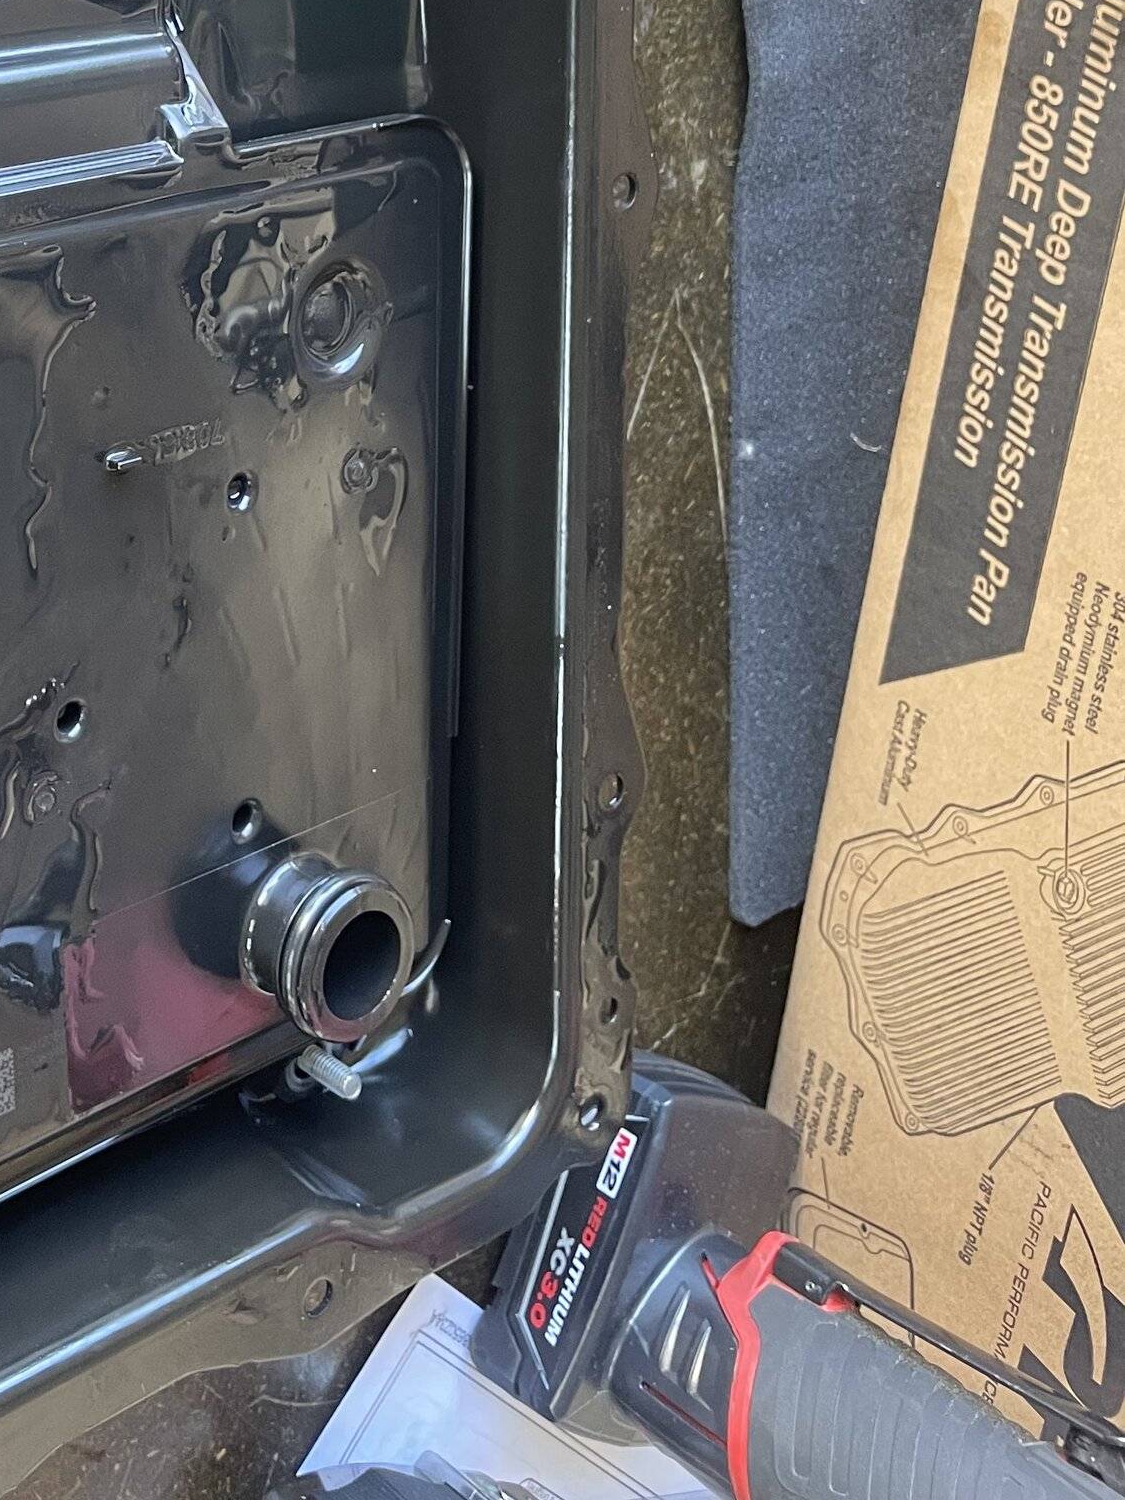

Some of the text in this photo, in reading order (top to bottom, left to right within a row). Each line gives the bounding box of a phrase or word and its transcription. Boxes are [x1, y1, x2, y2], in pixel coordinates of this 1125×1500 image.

[1043, 50, 1055, 68] -
[1008, 74, 1064, 212] 850RE
[1035, 178, 1092, 286] Deep
[954, 214, 1035, 468] Transmission
[984, 294, 1067, 548] Transmission
[967, 547, 1010, 627] Pan
[1041, 571, 1088, 724] equipped drain plug
[1061, 581, 1110, 737] Neodymium magnet
[1093, 622, 1121, 693] stainless
[878, 699, 910, 806] Cast Aluminum
[896, 707, 927, 793] Heavy-Duty
[1084, 693, 1103, 735] steel
[800, 1048, 817, 1096] service
[814, 1090, 828, 1114] for
[824, 1071, 847, 1147] replaceable
[602, 1132, 632, 1192] M12
[805, 1110, 822, 1160] regular
[957, 1172, 996, 1266] 1/8" NPT plug
[981, 1180, 1052, 1405] PACIFIC PERFORMCE
